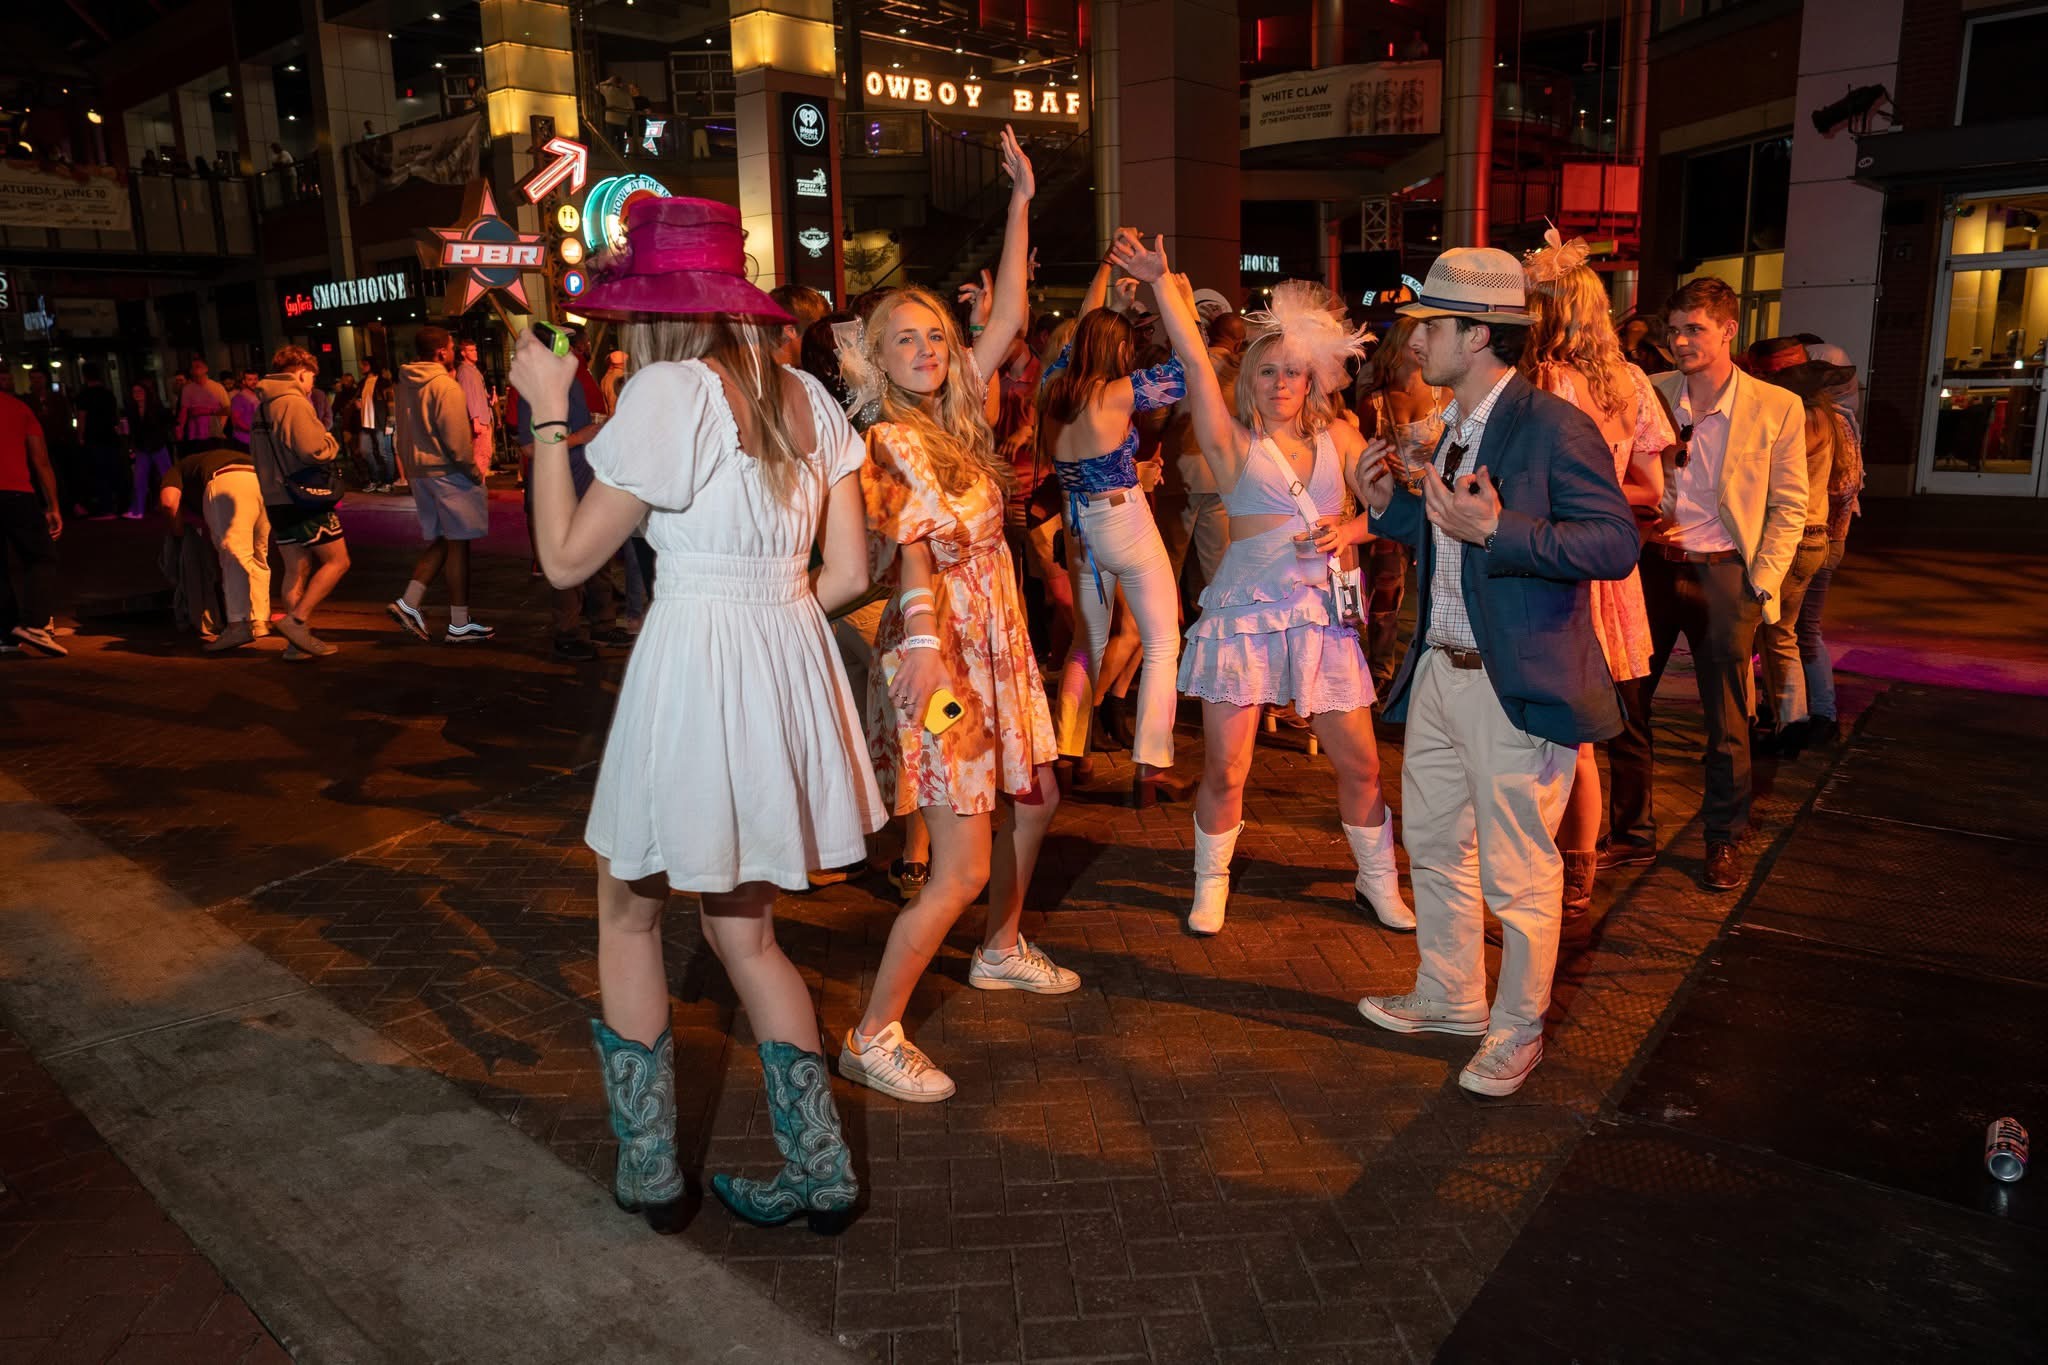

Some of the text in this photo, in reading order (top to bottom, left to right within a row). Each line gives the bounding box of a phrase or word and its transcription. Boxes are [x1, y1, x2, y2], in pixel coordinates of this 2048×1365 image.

[842, 71, 982, 108] OWBOY
[1262, 83, 1329, 101] WHITE CLAW
[0, 184, 61, 200] ATURDAY,
[64, 188, 93, 198] JUNE
[613, 180, 660, 215] HOWL AT THE
[451, 243, 539, 265] PBR
[1240, 254, 1280, 273] HOUSE
[312, 272, 407, 311] SMOKEHOUSE
[569, 275, 580, 292] P
